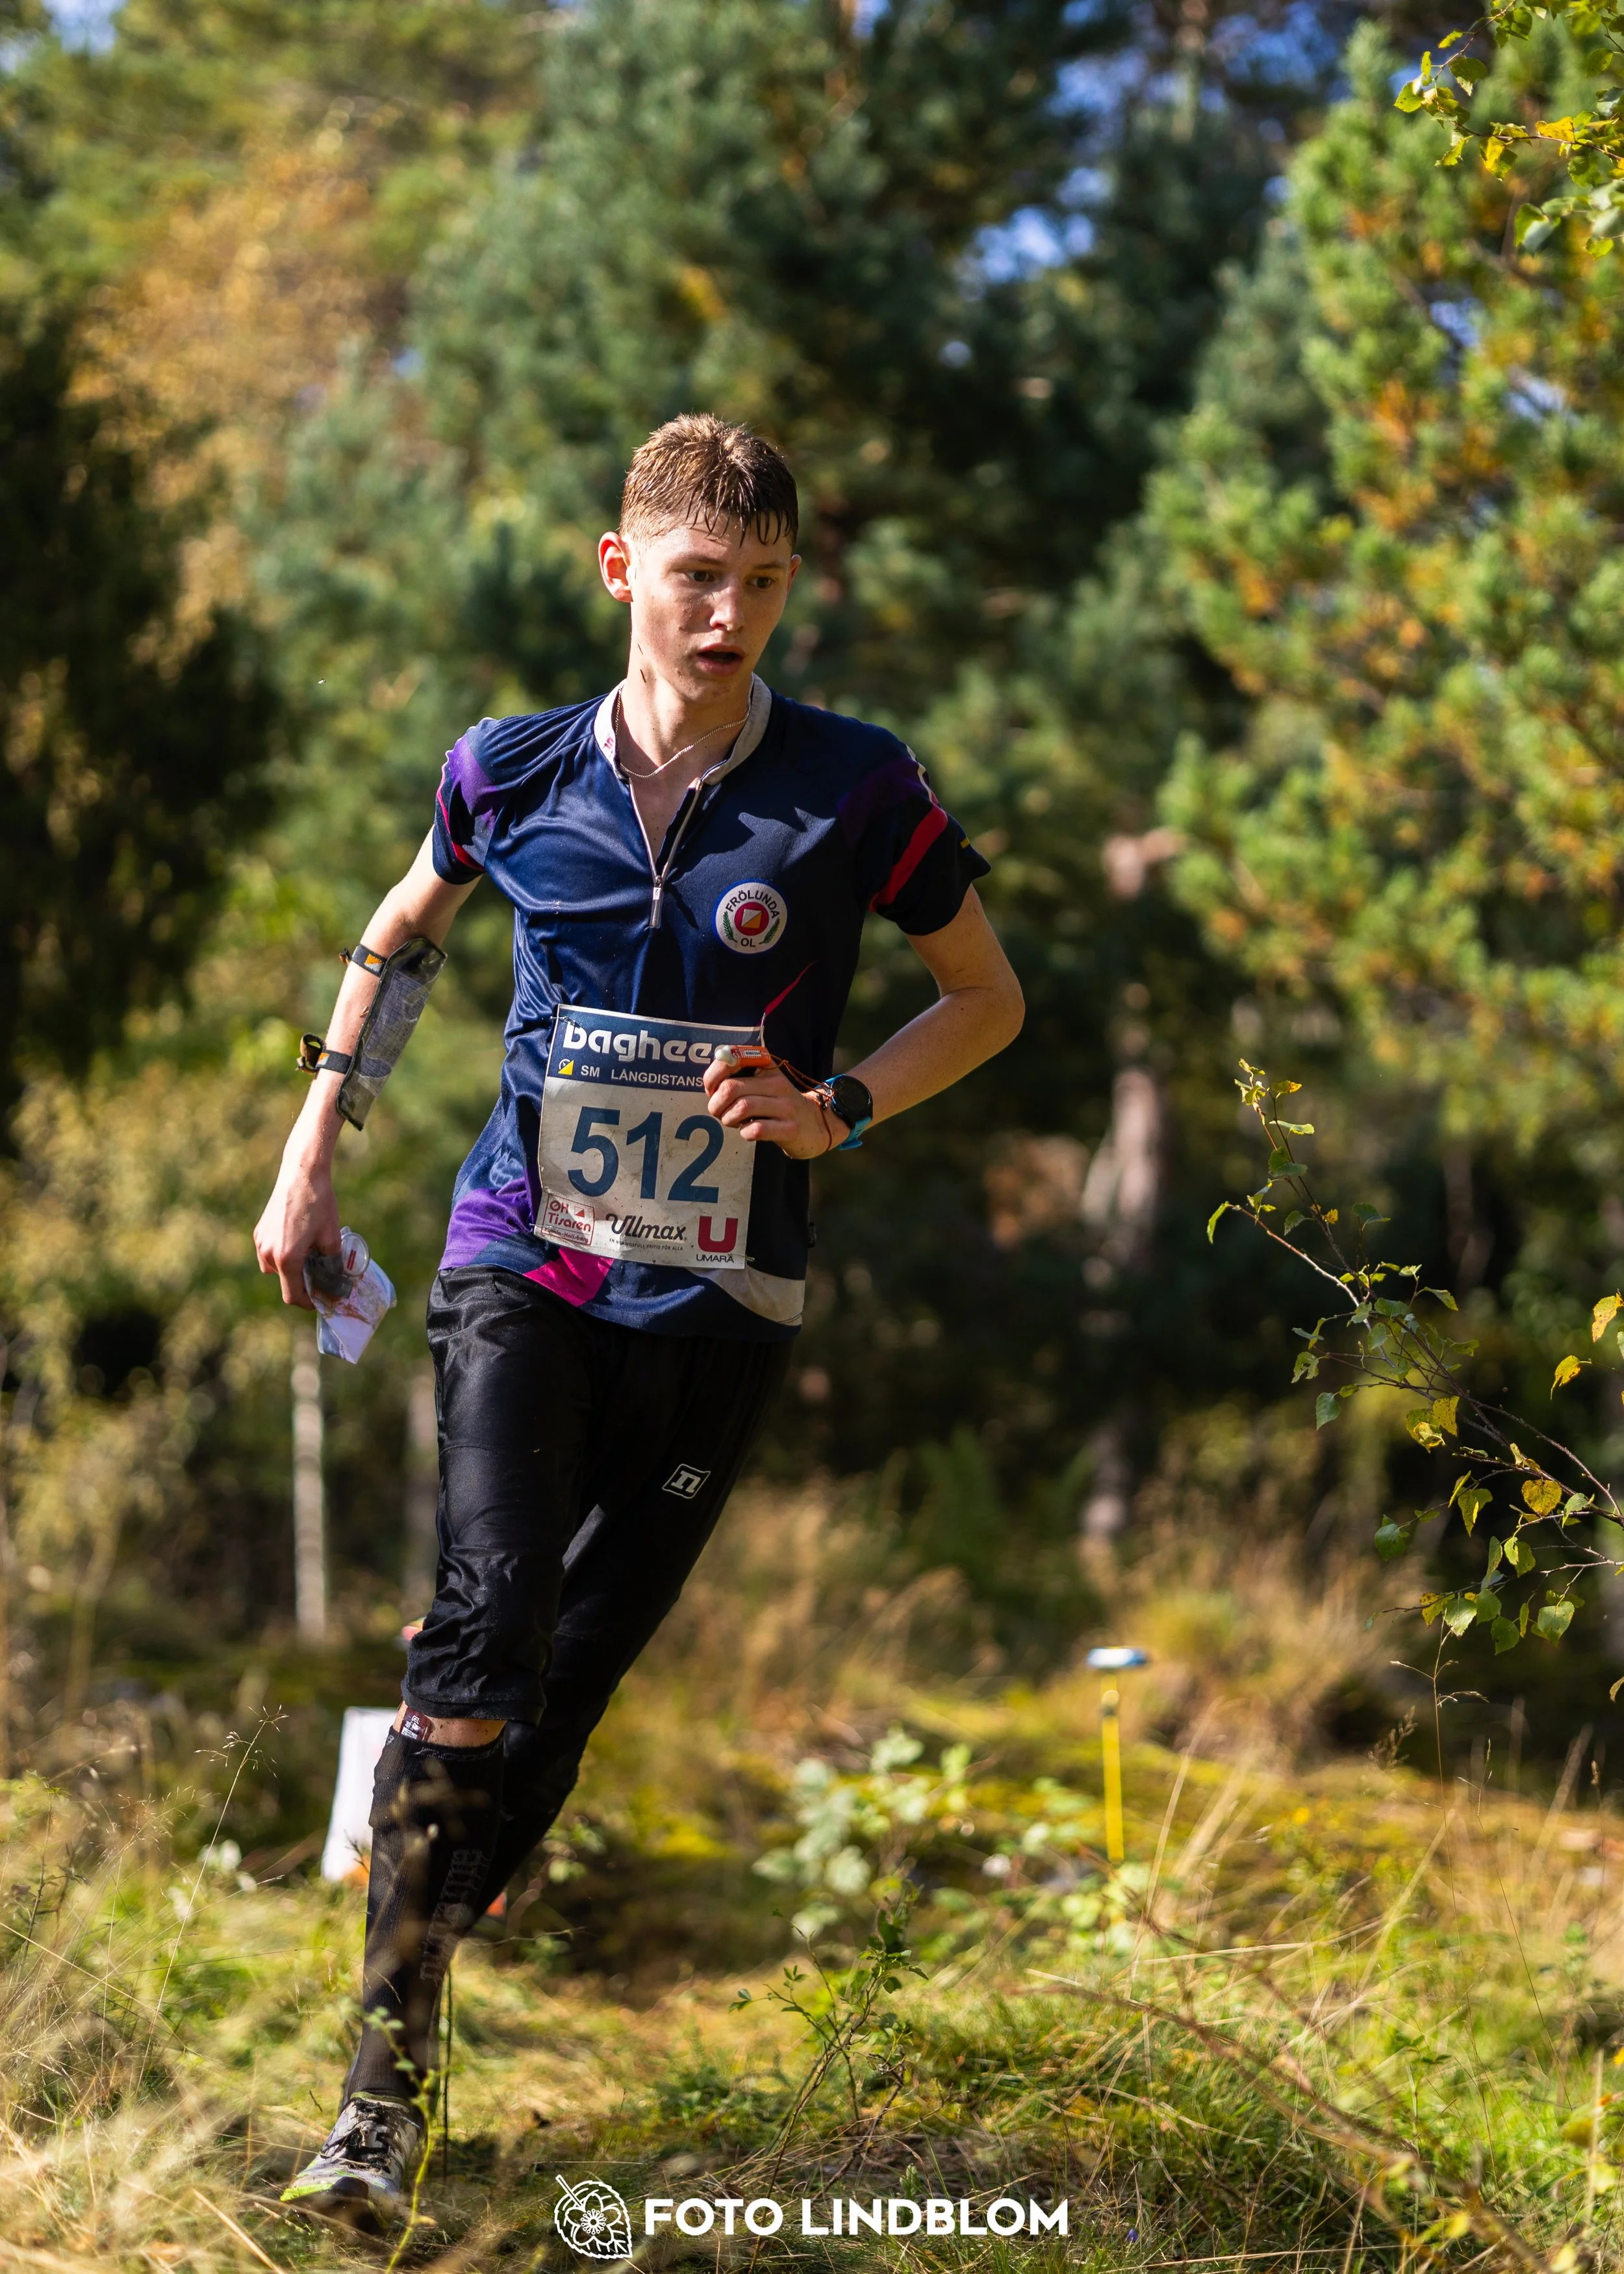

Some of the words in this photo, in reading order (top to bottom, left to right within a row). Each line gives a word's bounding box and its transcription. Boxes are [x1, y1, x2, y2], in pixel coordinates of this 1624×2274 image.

[726, 890, 780, 919] FRÖLUNDA
[741, 938, 756, 947] OL
[563, 1021, 728, 1065] baghee
[581, 1065, 600, 1078] SM
[611, 1068, 704, 1087] LÅNGDISTANS
[567, 1106, 724, 1203] 512
[548, 1212, 591, 1232] Tisaren
[605, 1213, 687, 1240] Ullmax
[696, 1253, 735, 1264] UMARA
